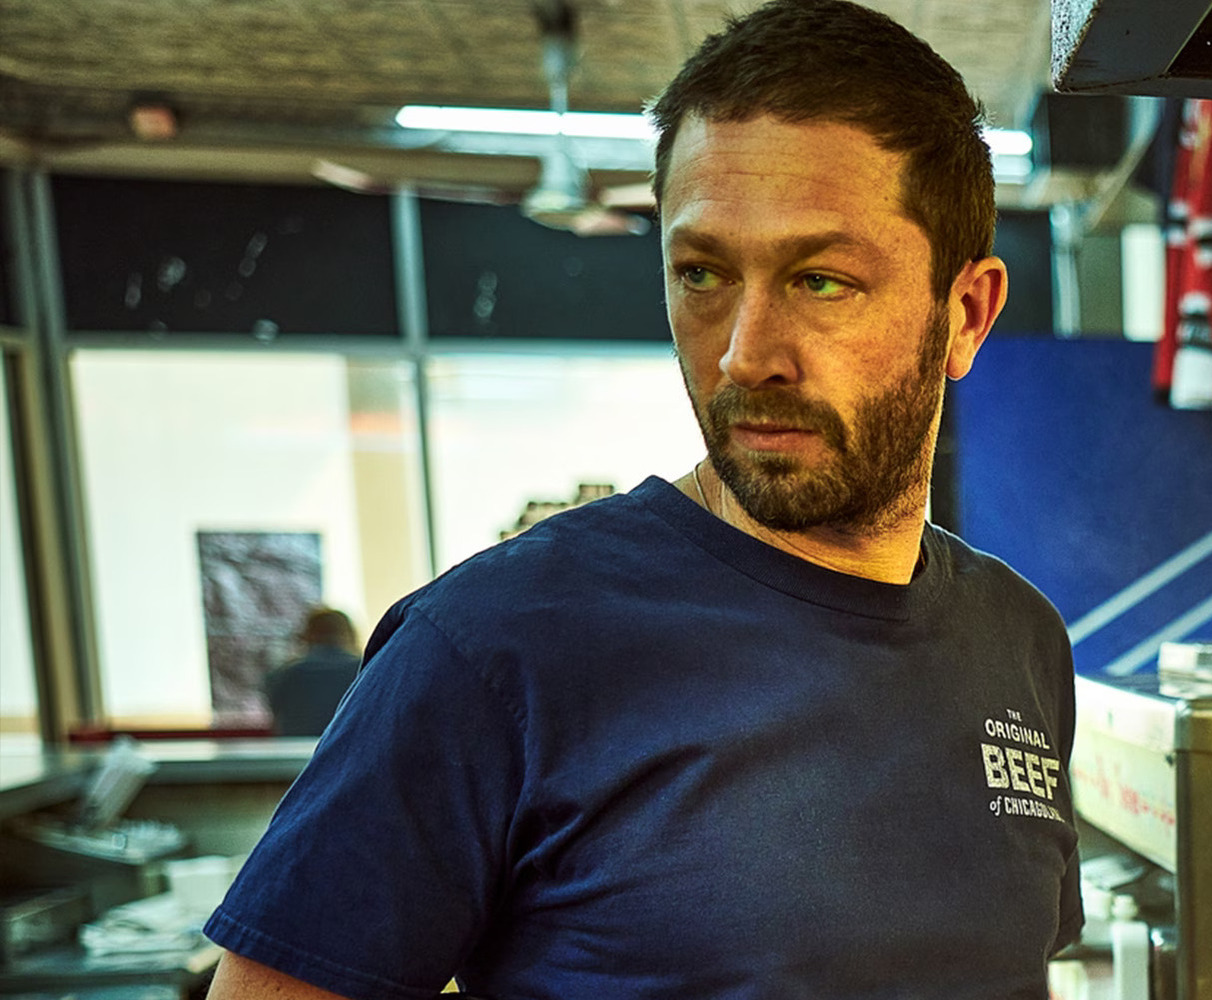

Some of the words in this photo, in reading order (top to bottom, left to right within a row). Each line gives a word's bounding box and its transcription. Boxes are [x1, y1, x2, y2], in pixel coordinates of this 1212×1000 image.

[1006, 708, 1022, 721] THE
[985, 718, 1050, 750] ORIGINAL
[981, 743, 1060, 800] BEEF
[989, 795, 1002, 816] of
